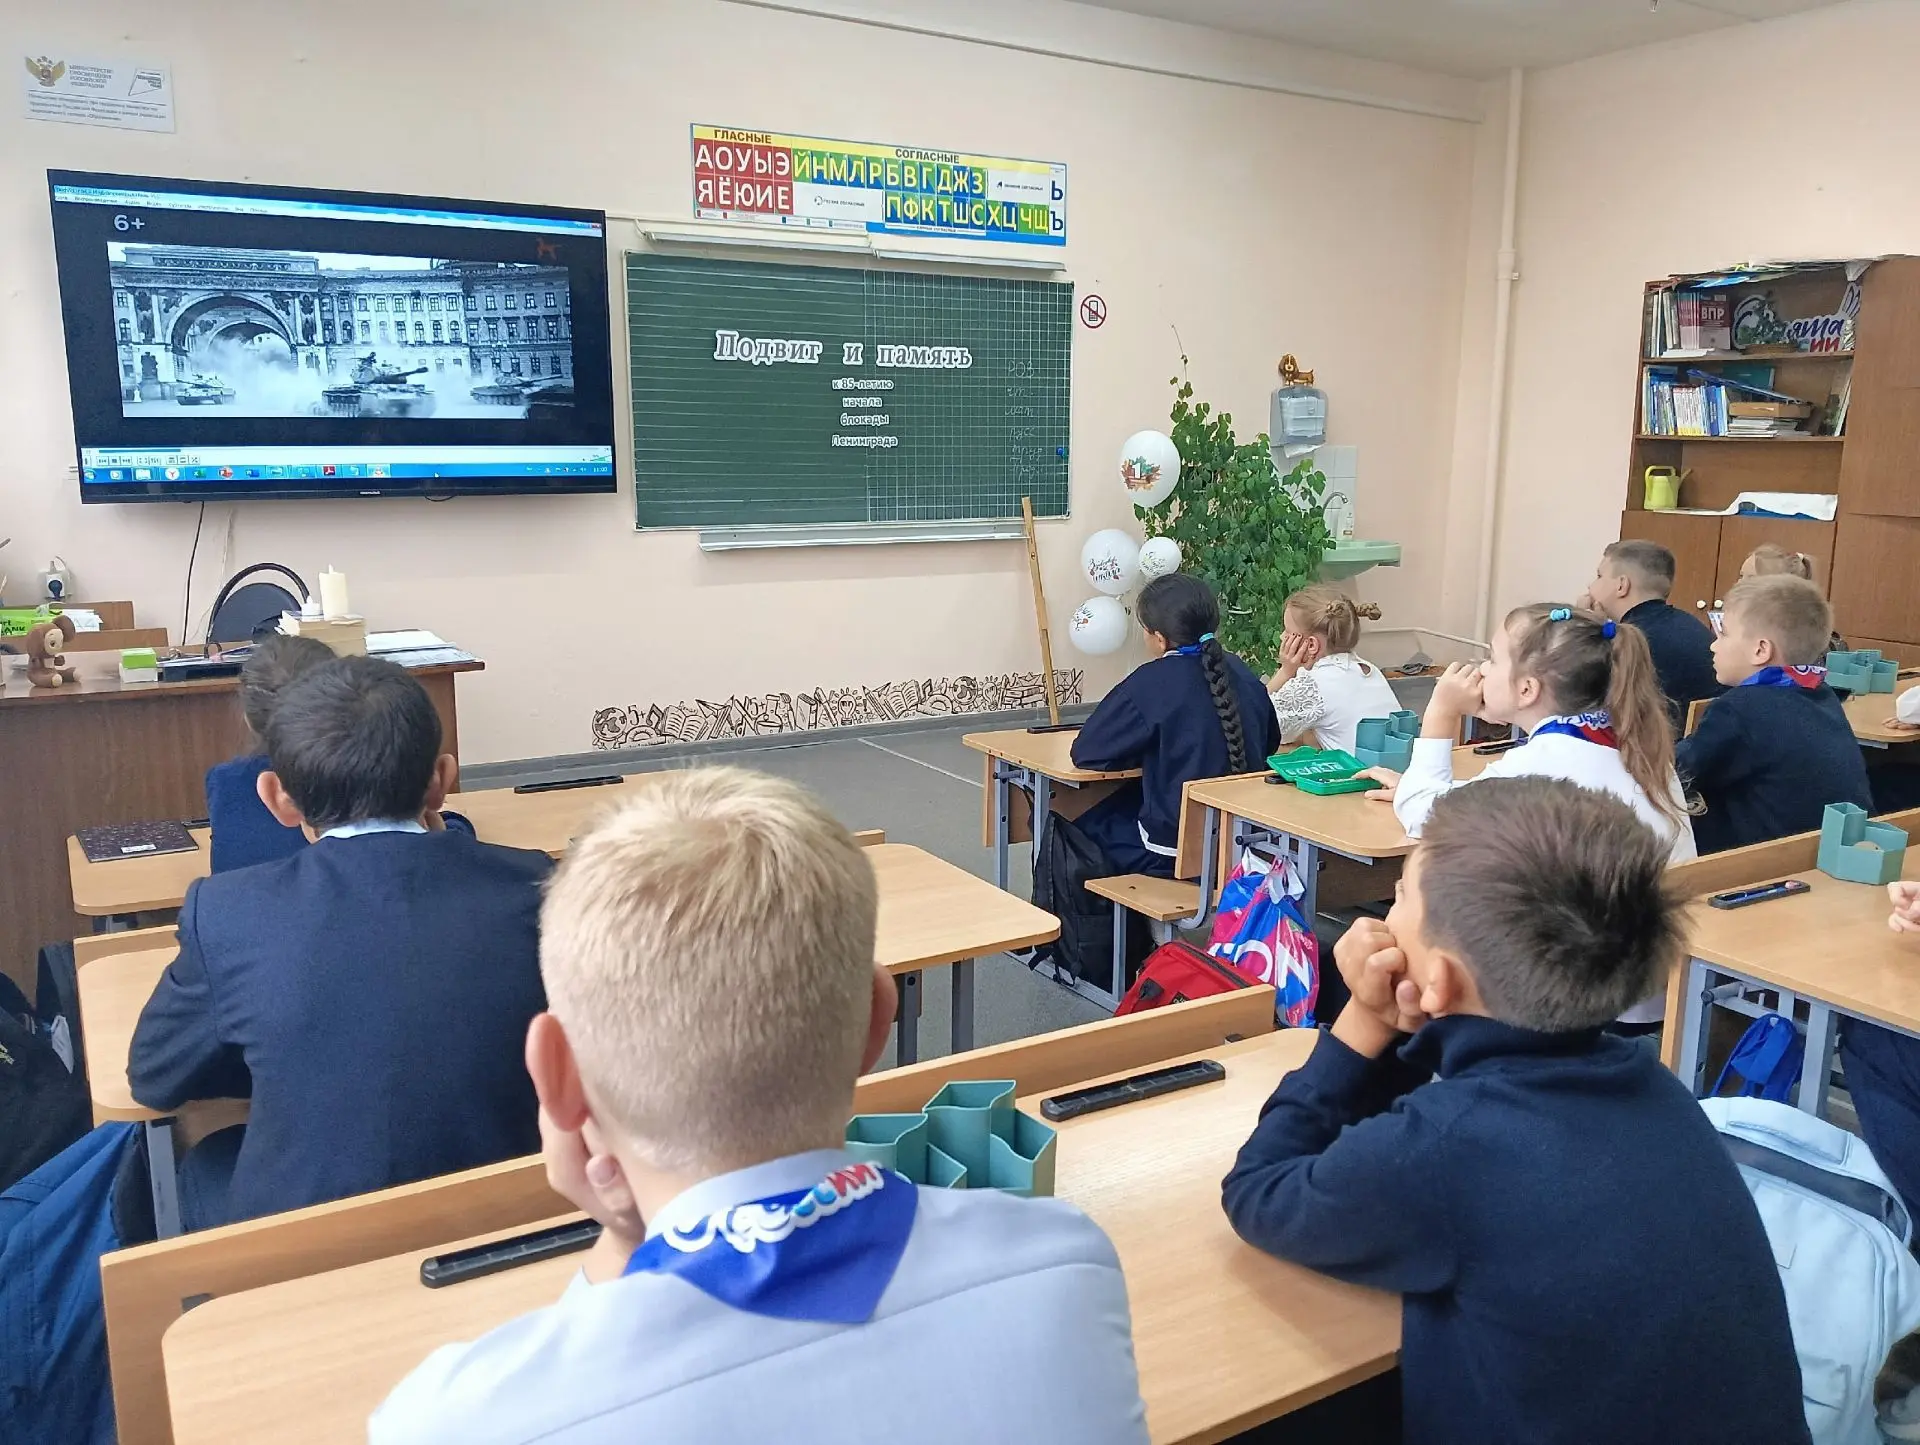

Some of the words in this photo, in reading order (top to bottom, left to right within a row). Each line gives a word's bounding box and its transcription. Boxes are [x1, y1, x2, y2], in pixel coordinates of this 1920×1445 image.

[713, 129, 772, 144] ГЛАСНЫЕ
[895, 148, 960, 164] СОГЛАСНЫЕ
[113, 214, 145, 231] 6+
[1701, 307, 1725, 320] ВПР
[714, 330, 823, 365] Подвиг
[843, 342, 863, 365] и
[876, 343, 972, 369] память
[832, 379, 841, 390] к
[842, 378, 895, 391] 85-летию
[842, 396, 882, 408] начала
[840, 413, 889, 426] блокады
[831, 434, 898, 448] Ленинграда
[1132, 462, 1141, 479] 1
[627, 704, 646, 726] 5+
